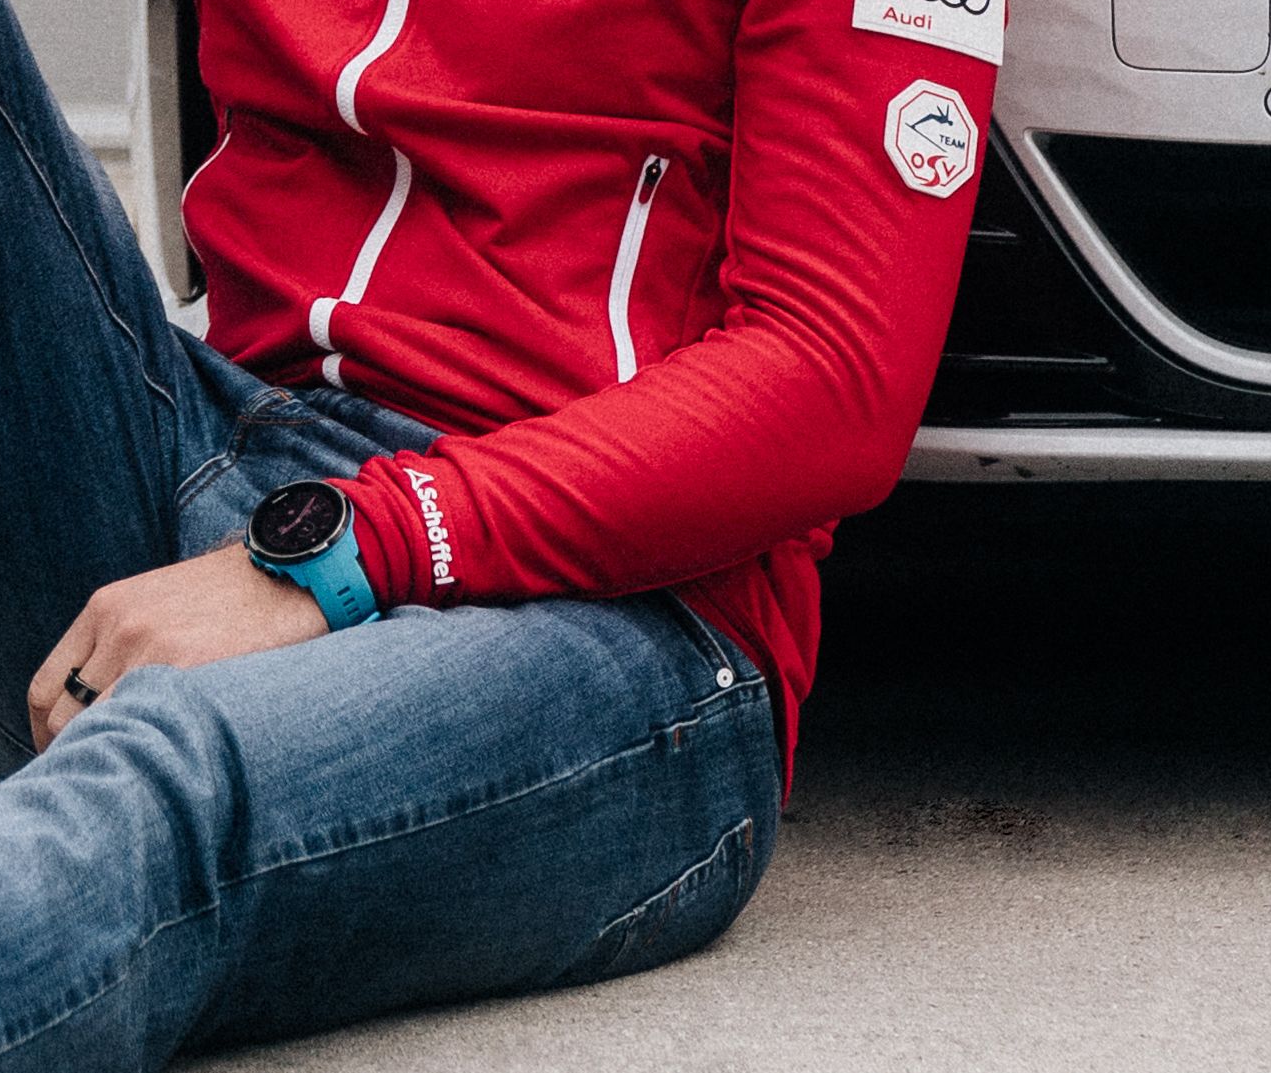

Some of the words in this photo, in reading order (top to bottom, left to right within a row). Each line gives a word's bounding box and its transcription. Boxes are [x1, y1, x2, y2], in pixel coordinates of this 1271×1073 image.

[882, 6, 933, 30] Audi
[939, 134, 966, 150] TEAM
[416, 486, 455, 586] Schöffel
